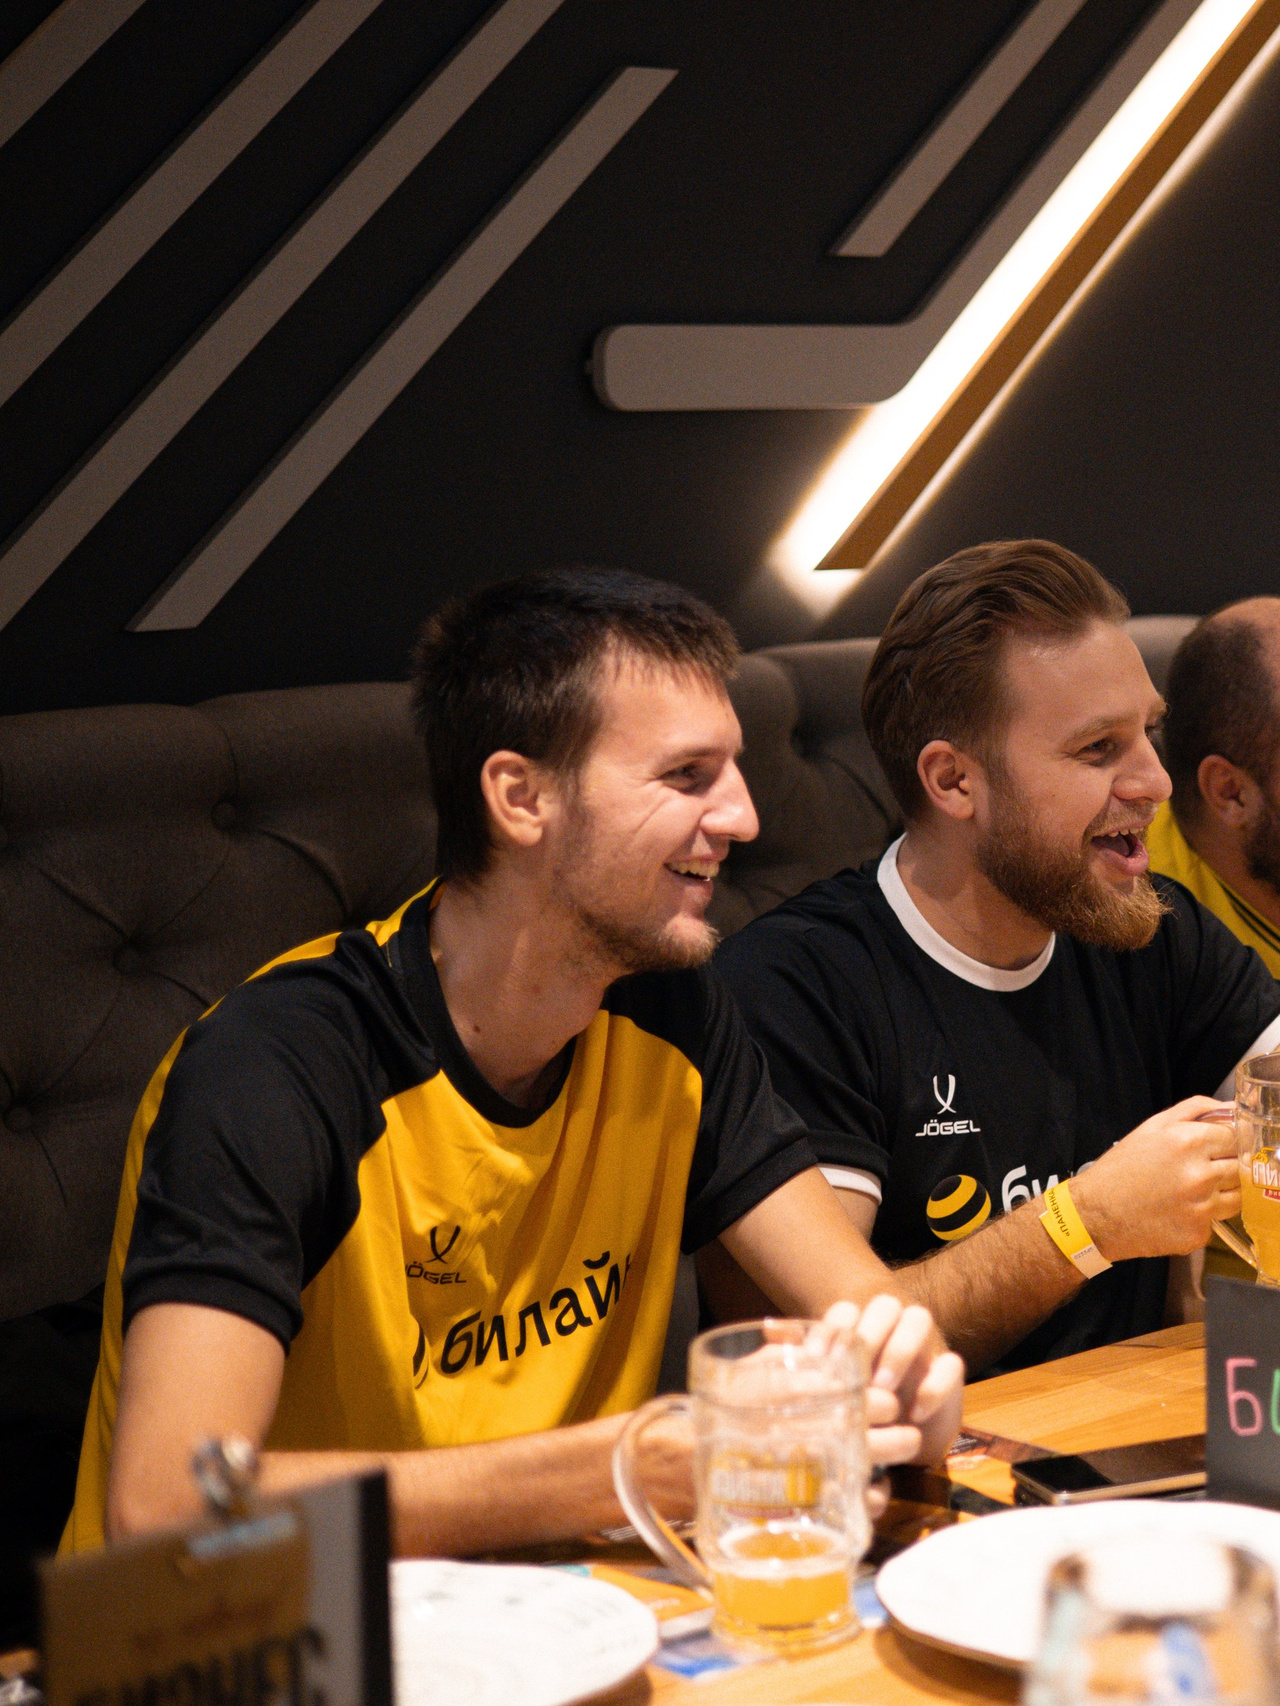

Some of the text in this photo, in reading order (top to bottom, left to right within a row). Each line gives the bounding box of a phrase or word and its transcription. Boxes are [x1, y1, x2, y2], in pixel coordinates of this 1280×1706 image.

[915, 1119, 981, 1137] JÖGEL
[404, 1261, 467, 1285] ÖGEL
[440, 1250, 632, 1375] билай
